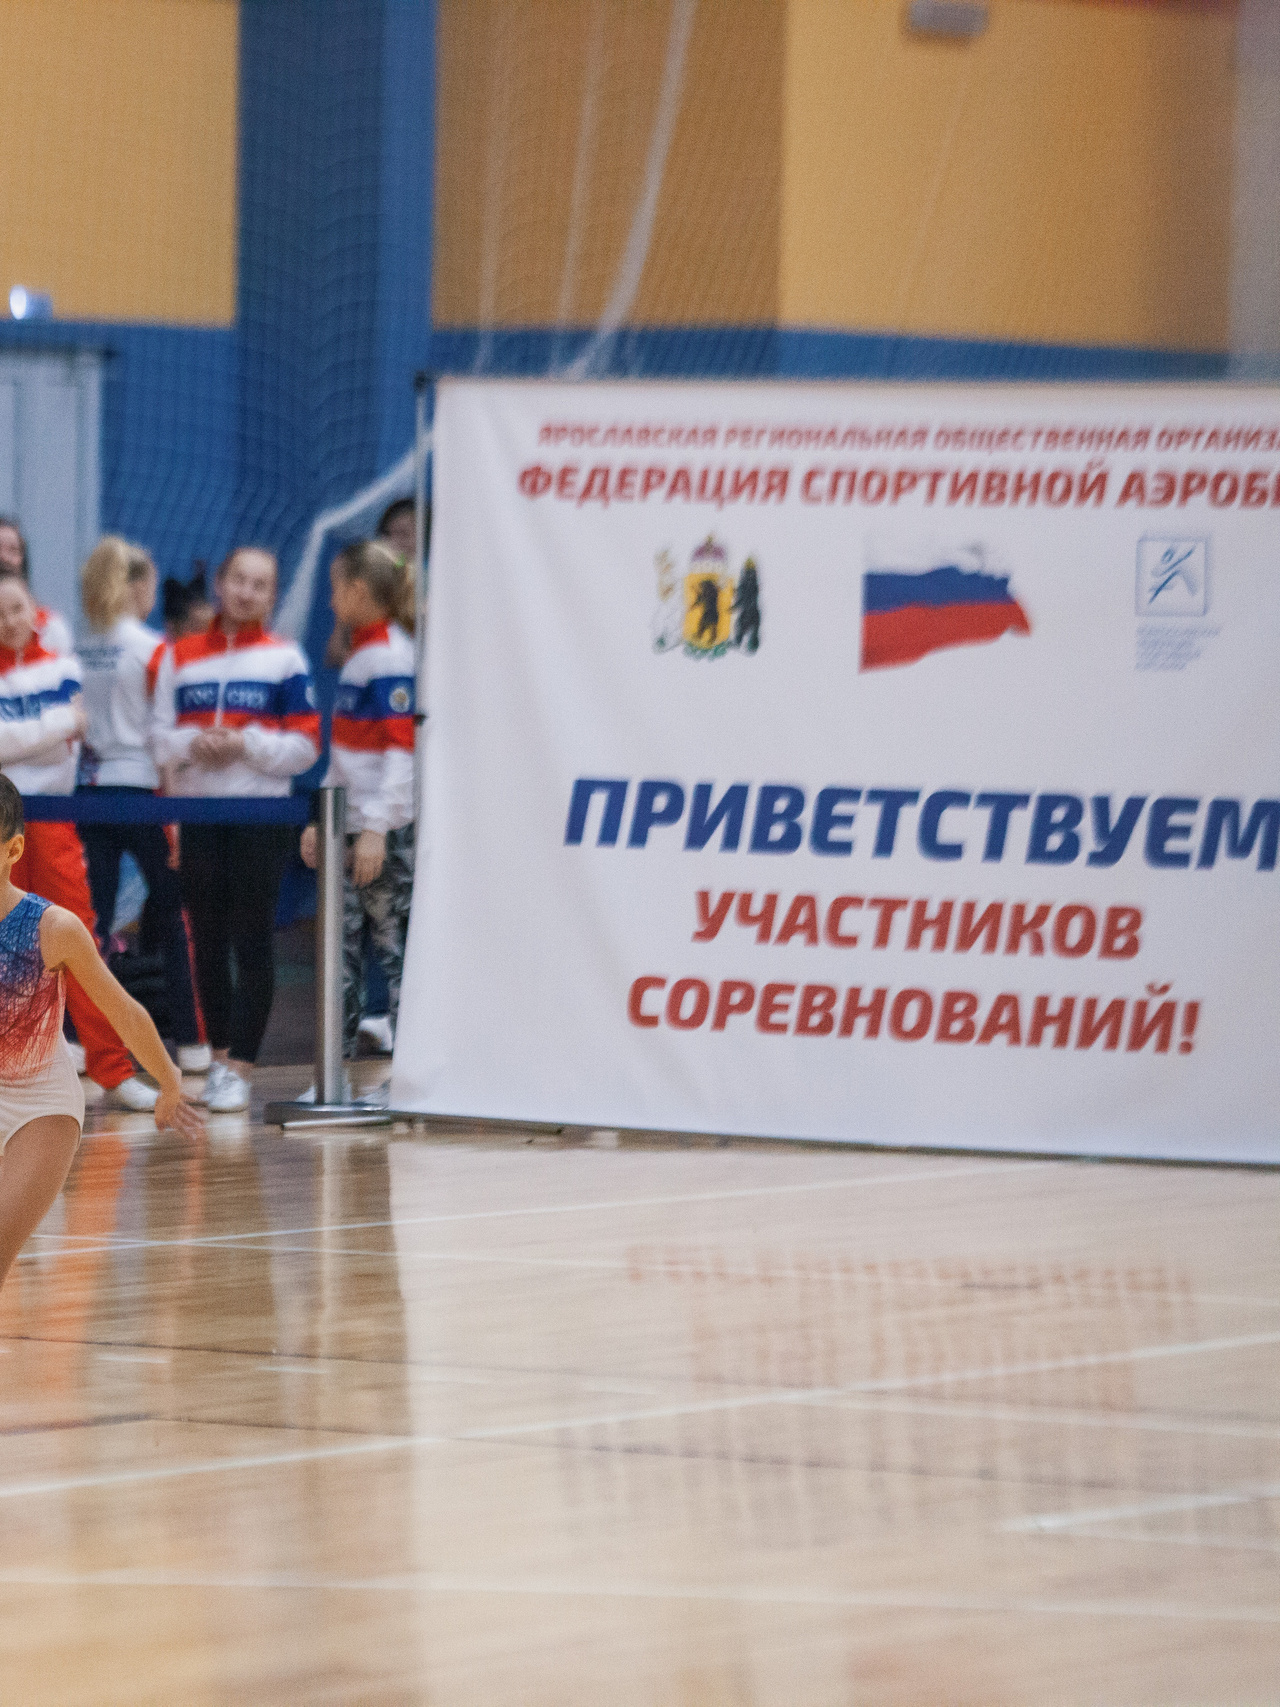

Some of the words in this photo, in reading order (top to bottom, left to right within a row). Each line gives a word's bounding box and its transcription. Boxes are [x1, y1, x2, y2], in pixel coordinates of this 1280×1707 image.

[724, 425, 928, 448] РЕГИОНАЛЬНАЯ
[934, 426, 1152, 452] ОБЩЕСТВЕННАЯ
[1156, 426, 1280, 451] ОРГАНИЗ
[518, 464, 790, 508] ФЕДЕРАЦИЯ
[801, 458, 1109, 507] СПОРТИВНОЙ
[565, 777, 1280, 871] ПРИВЕТСТВУЕМ
[693, 890, 1142, 960] УЧАСТНИКОВ
[627, 975, 1200, 1055] СОРЕВНОВАНИЙ!
